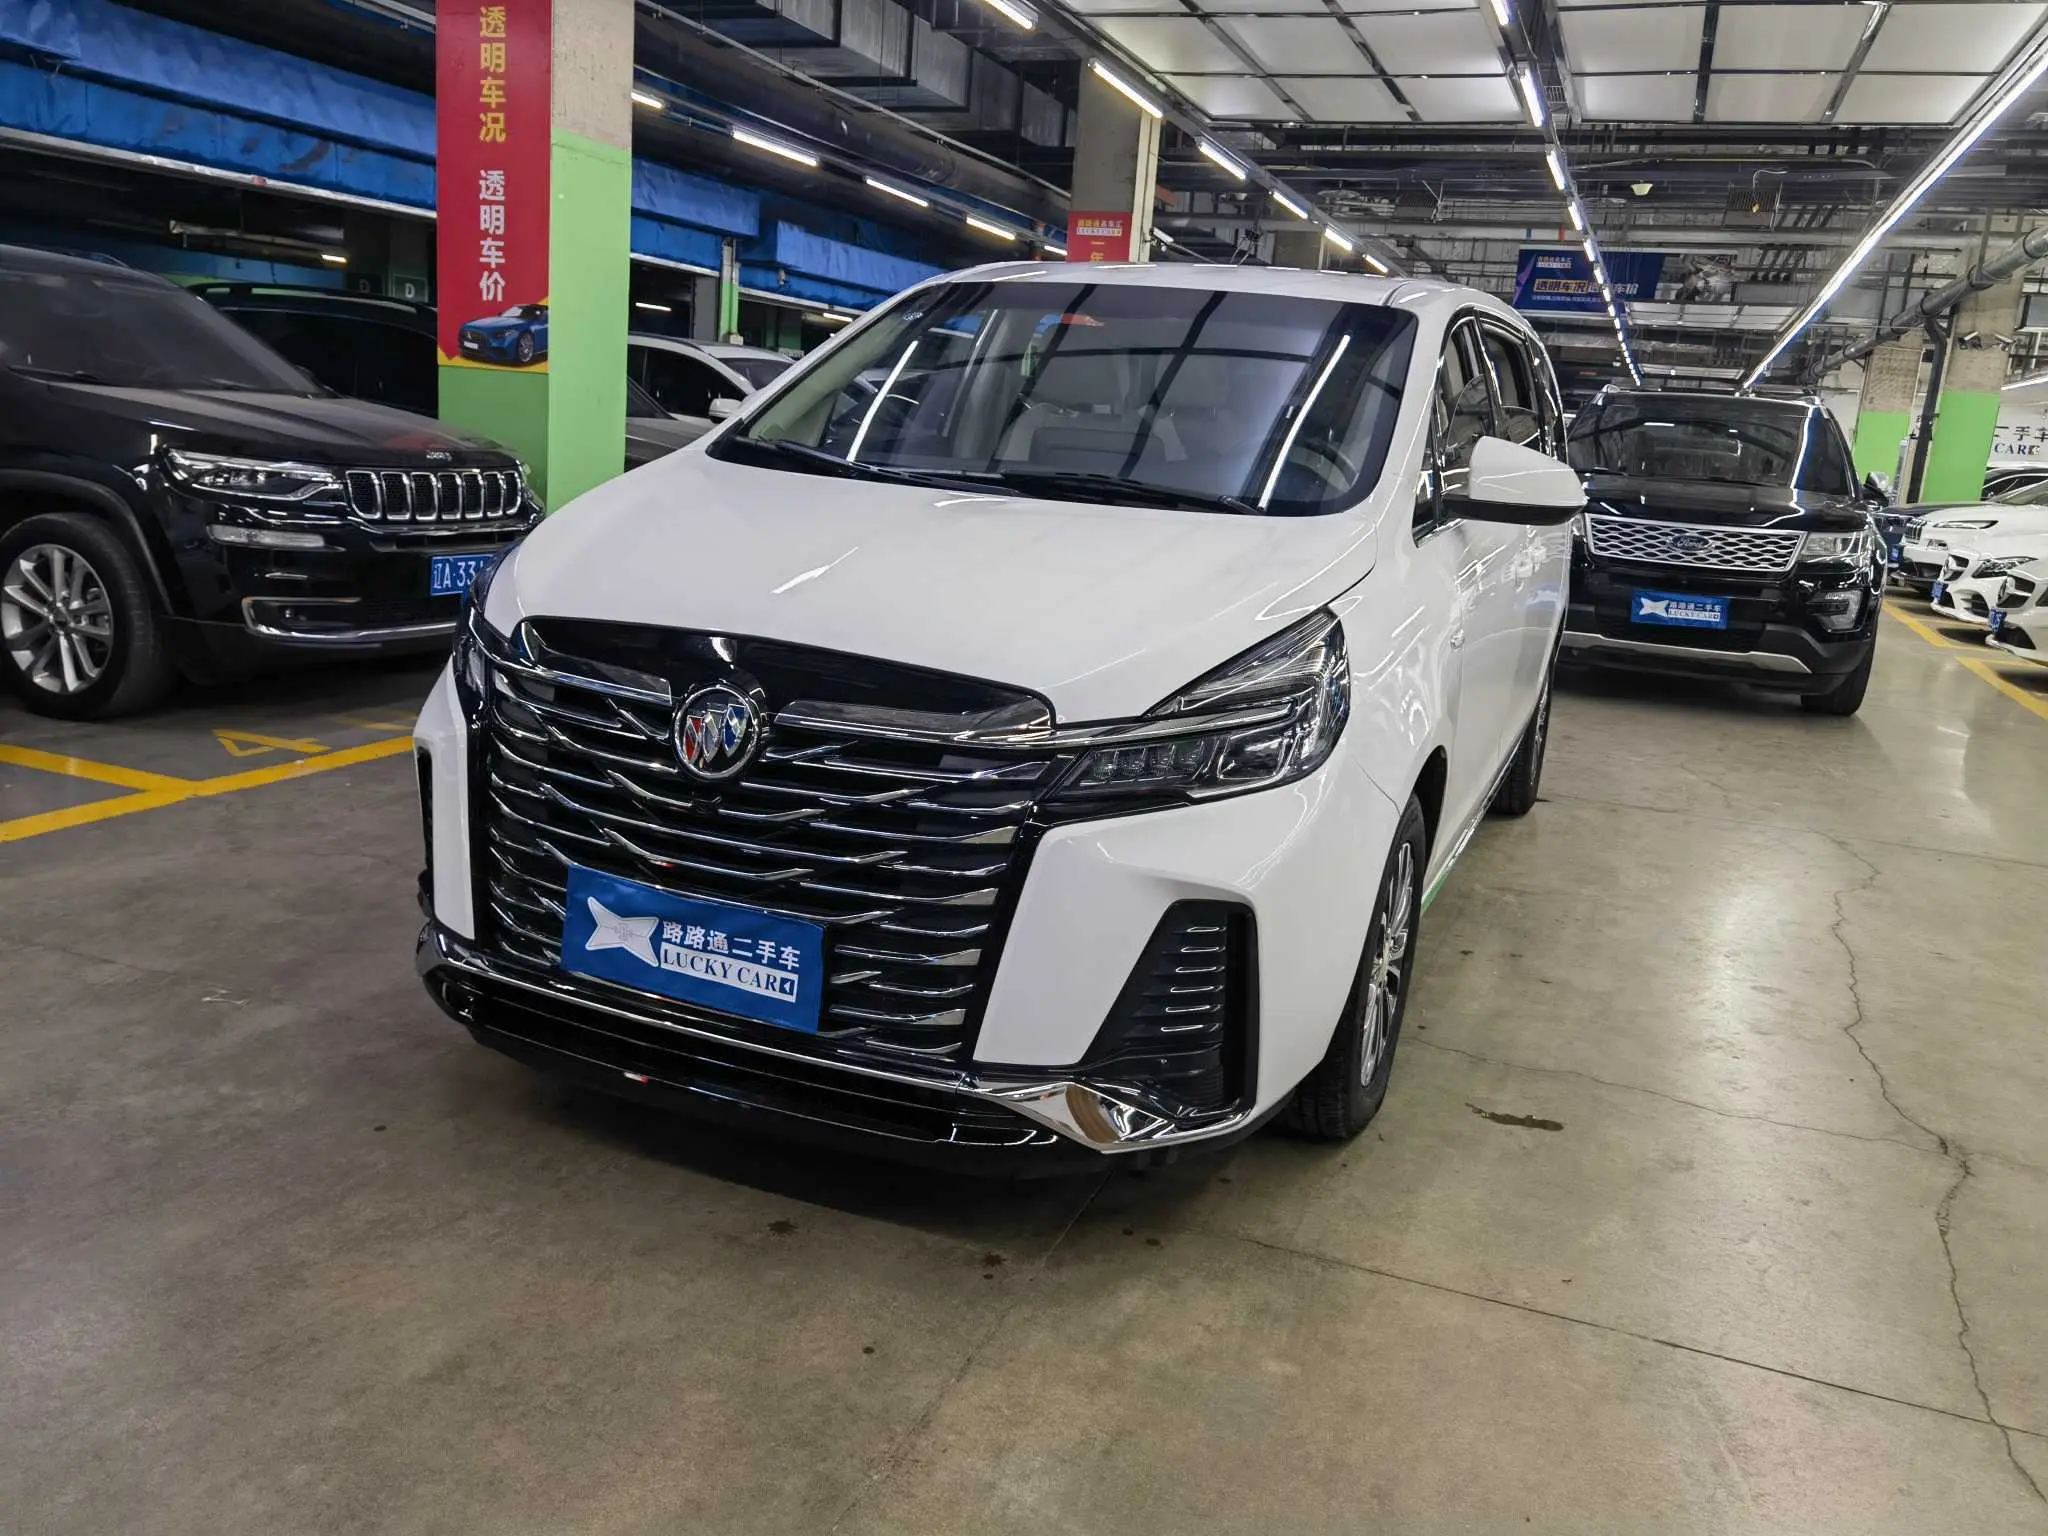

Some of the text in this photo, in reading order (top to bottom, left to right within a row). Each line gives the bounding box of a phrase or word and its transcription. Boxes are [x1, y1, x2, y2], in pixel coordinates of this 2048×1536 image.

[479, 6, 506, 142] 透明车况
[479, 170, 505, 302] 透明车价
[405, 282, 415, 298] D
[1994, 443, 2027, 455] CAR
[433, 560, 484, 588] 辽A·33
[662, 921, 800, 970] 路路通二手车
[663, 948, 778, 993] LUCKY CAR
